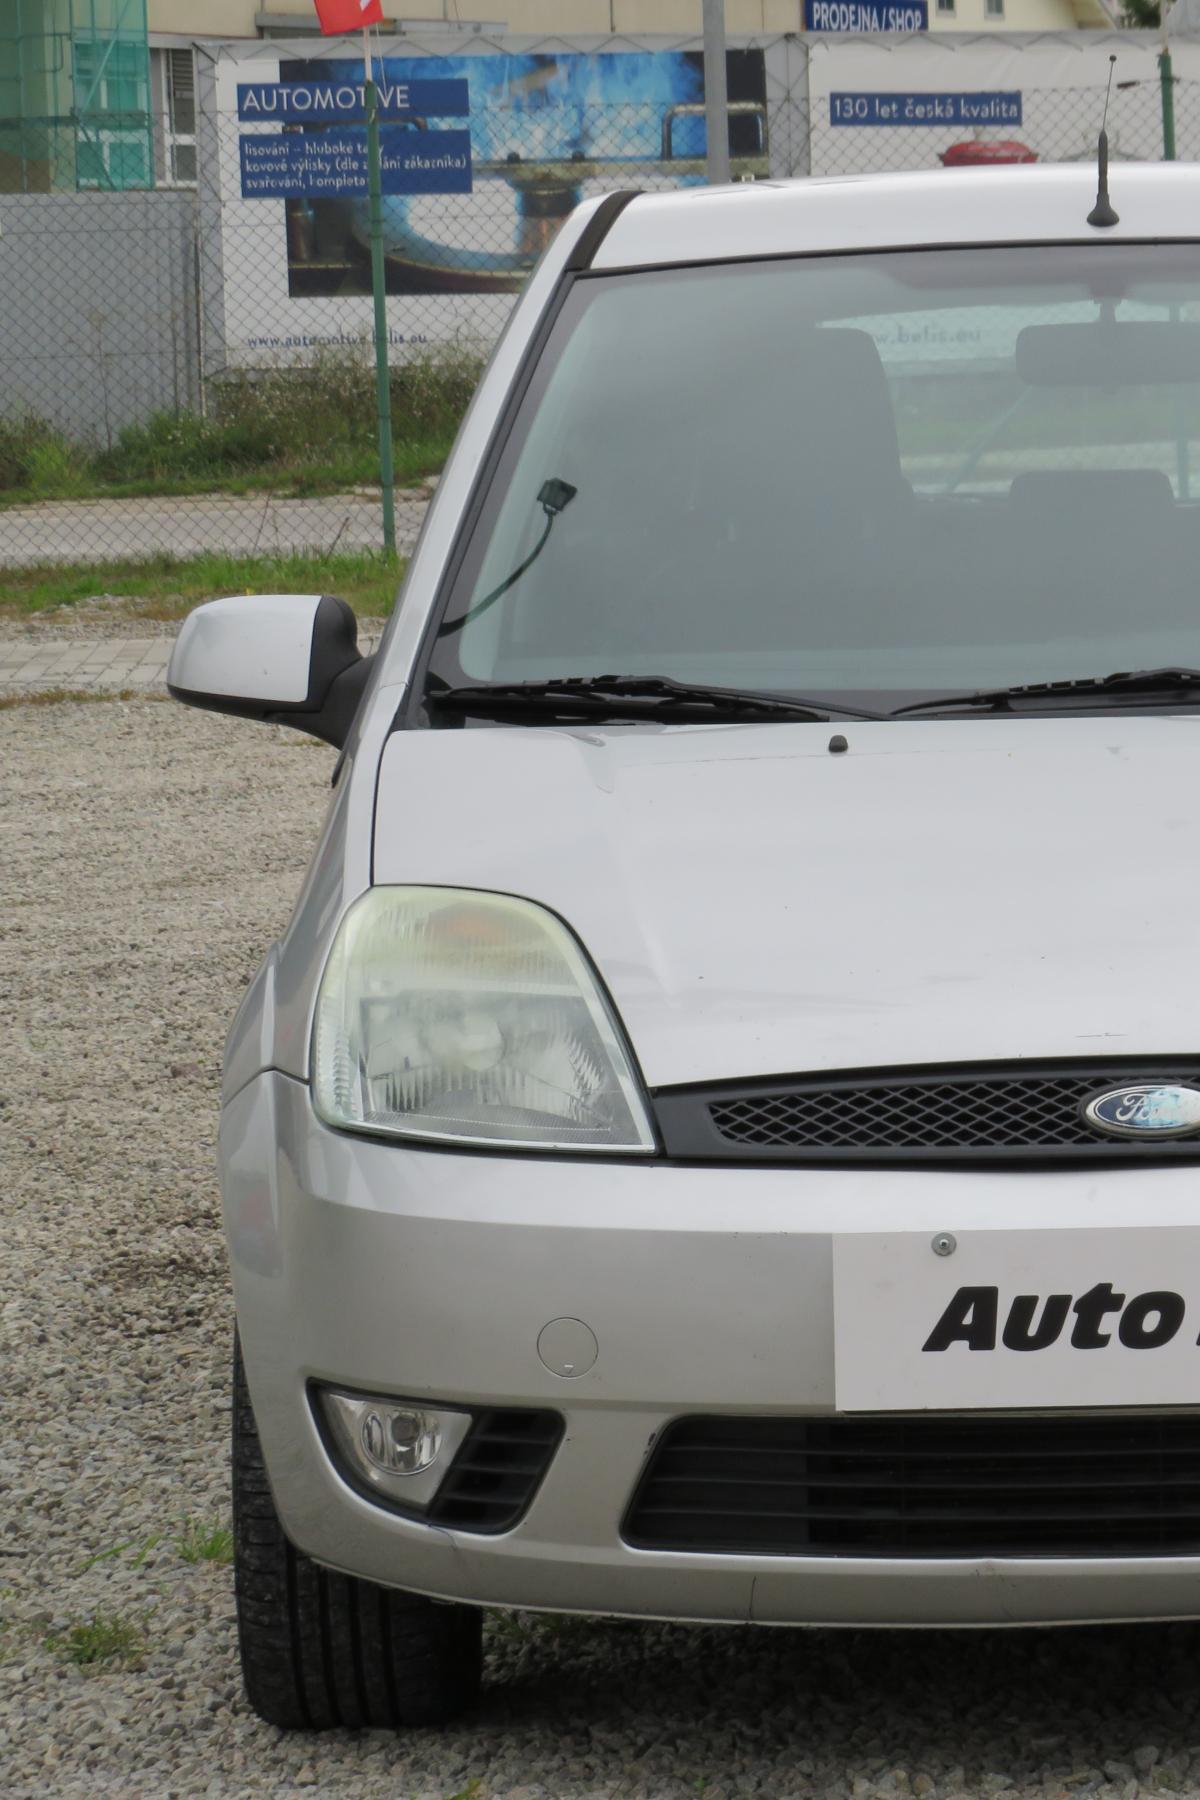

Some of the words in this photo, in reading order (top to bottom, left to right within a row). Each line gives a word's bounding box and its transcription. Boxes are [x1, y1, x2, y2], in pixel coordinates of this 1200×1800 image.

[242, 86, 410, 112] AUTOMOTVE
[835, 98, 868, 118] 130
[875, 98, 898, 119] let
[904, 98, 954, 119] česká
[960, 98, 1019, 119] kvalita
[245, 159, 288, 173] kovové
[291, 158, 332, 178] výlisky
[921, 1282, 1186, 1352] Auto
